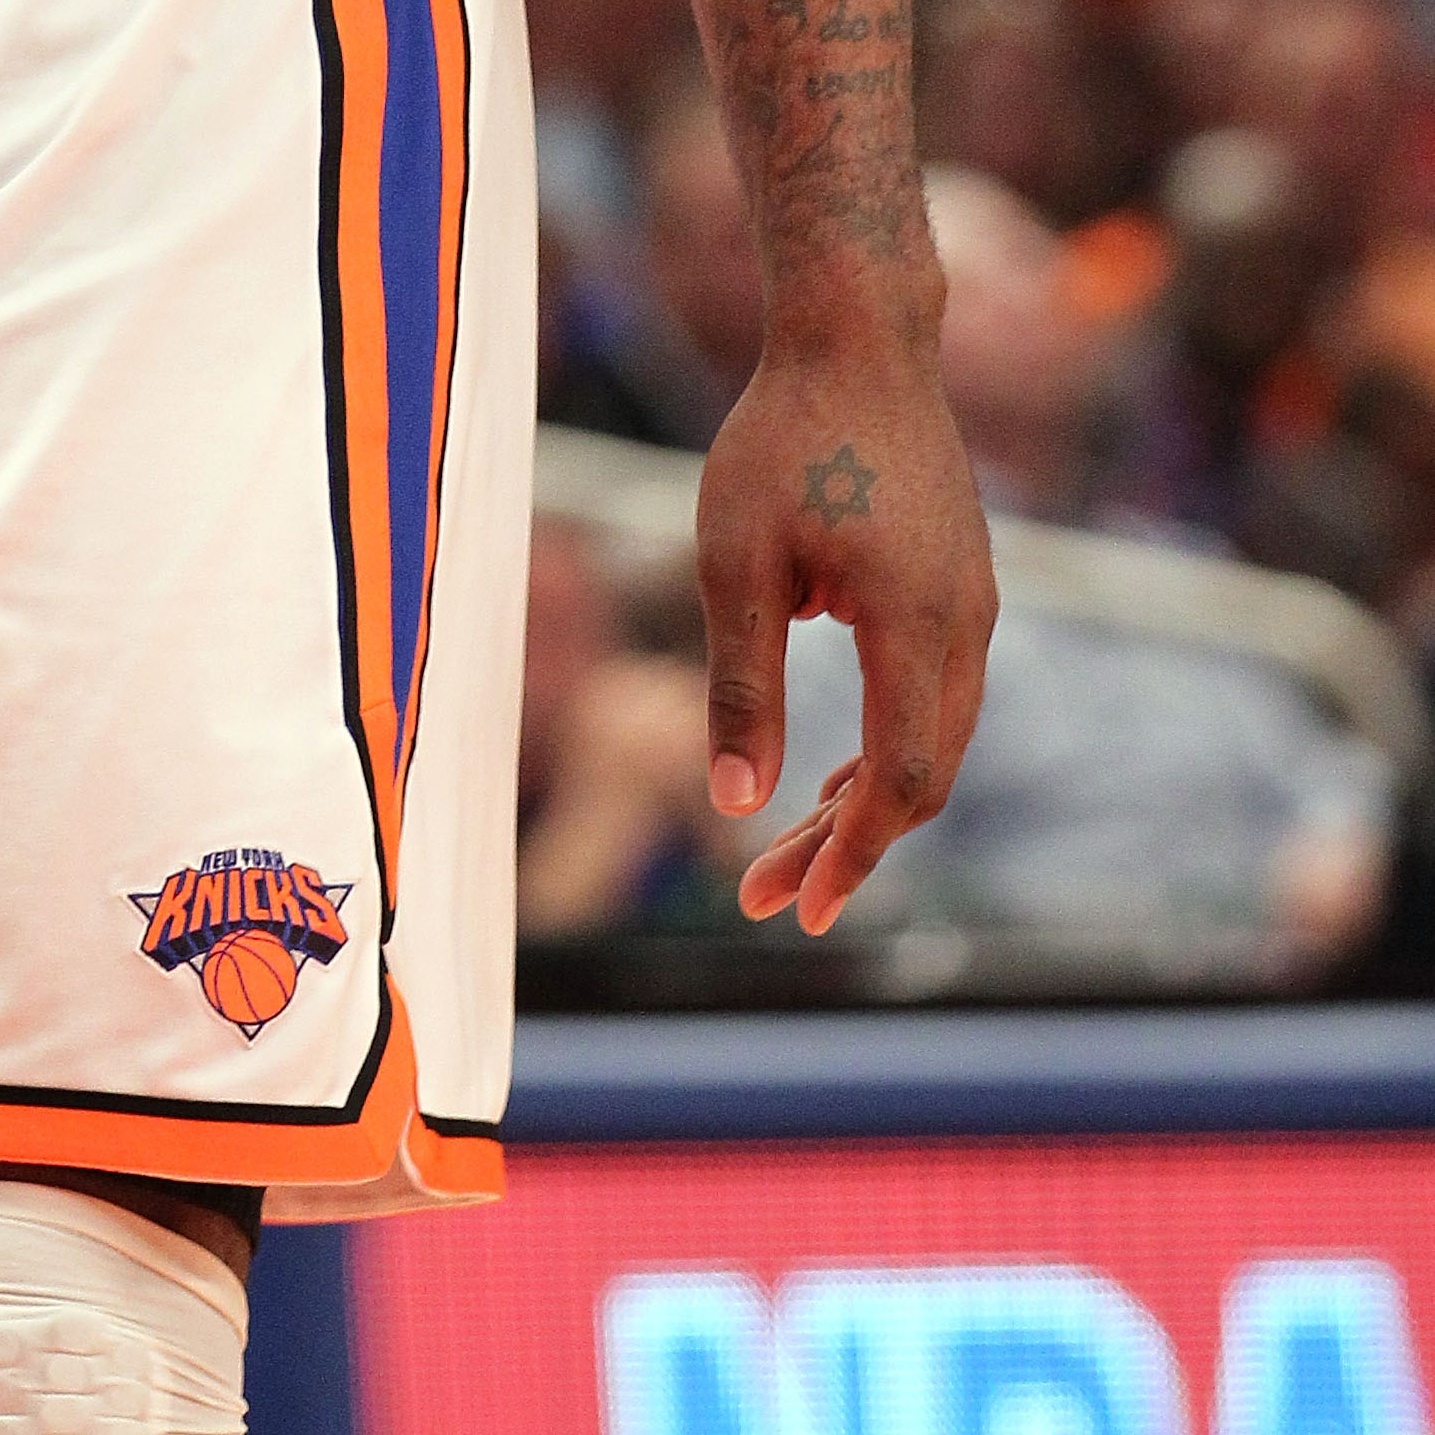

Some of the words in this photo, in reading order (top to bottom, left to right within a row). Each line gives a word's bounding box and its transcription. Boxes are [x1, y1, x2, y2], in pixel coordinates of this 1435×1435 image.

[200, 849, 237, 872] NEW
[241, 848, 285, 871] YORK
[140, 862, 348, 959] KNICKS
